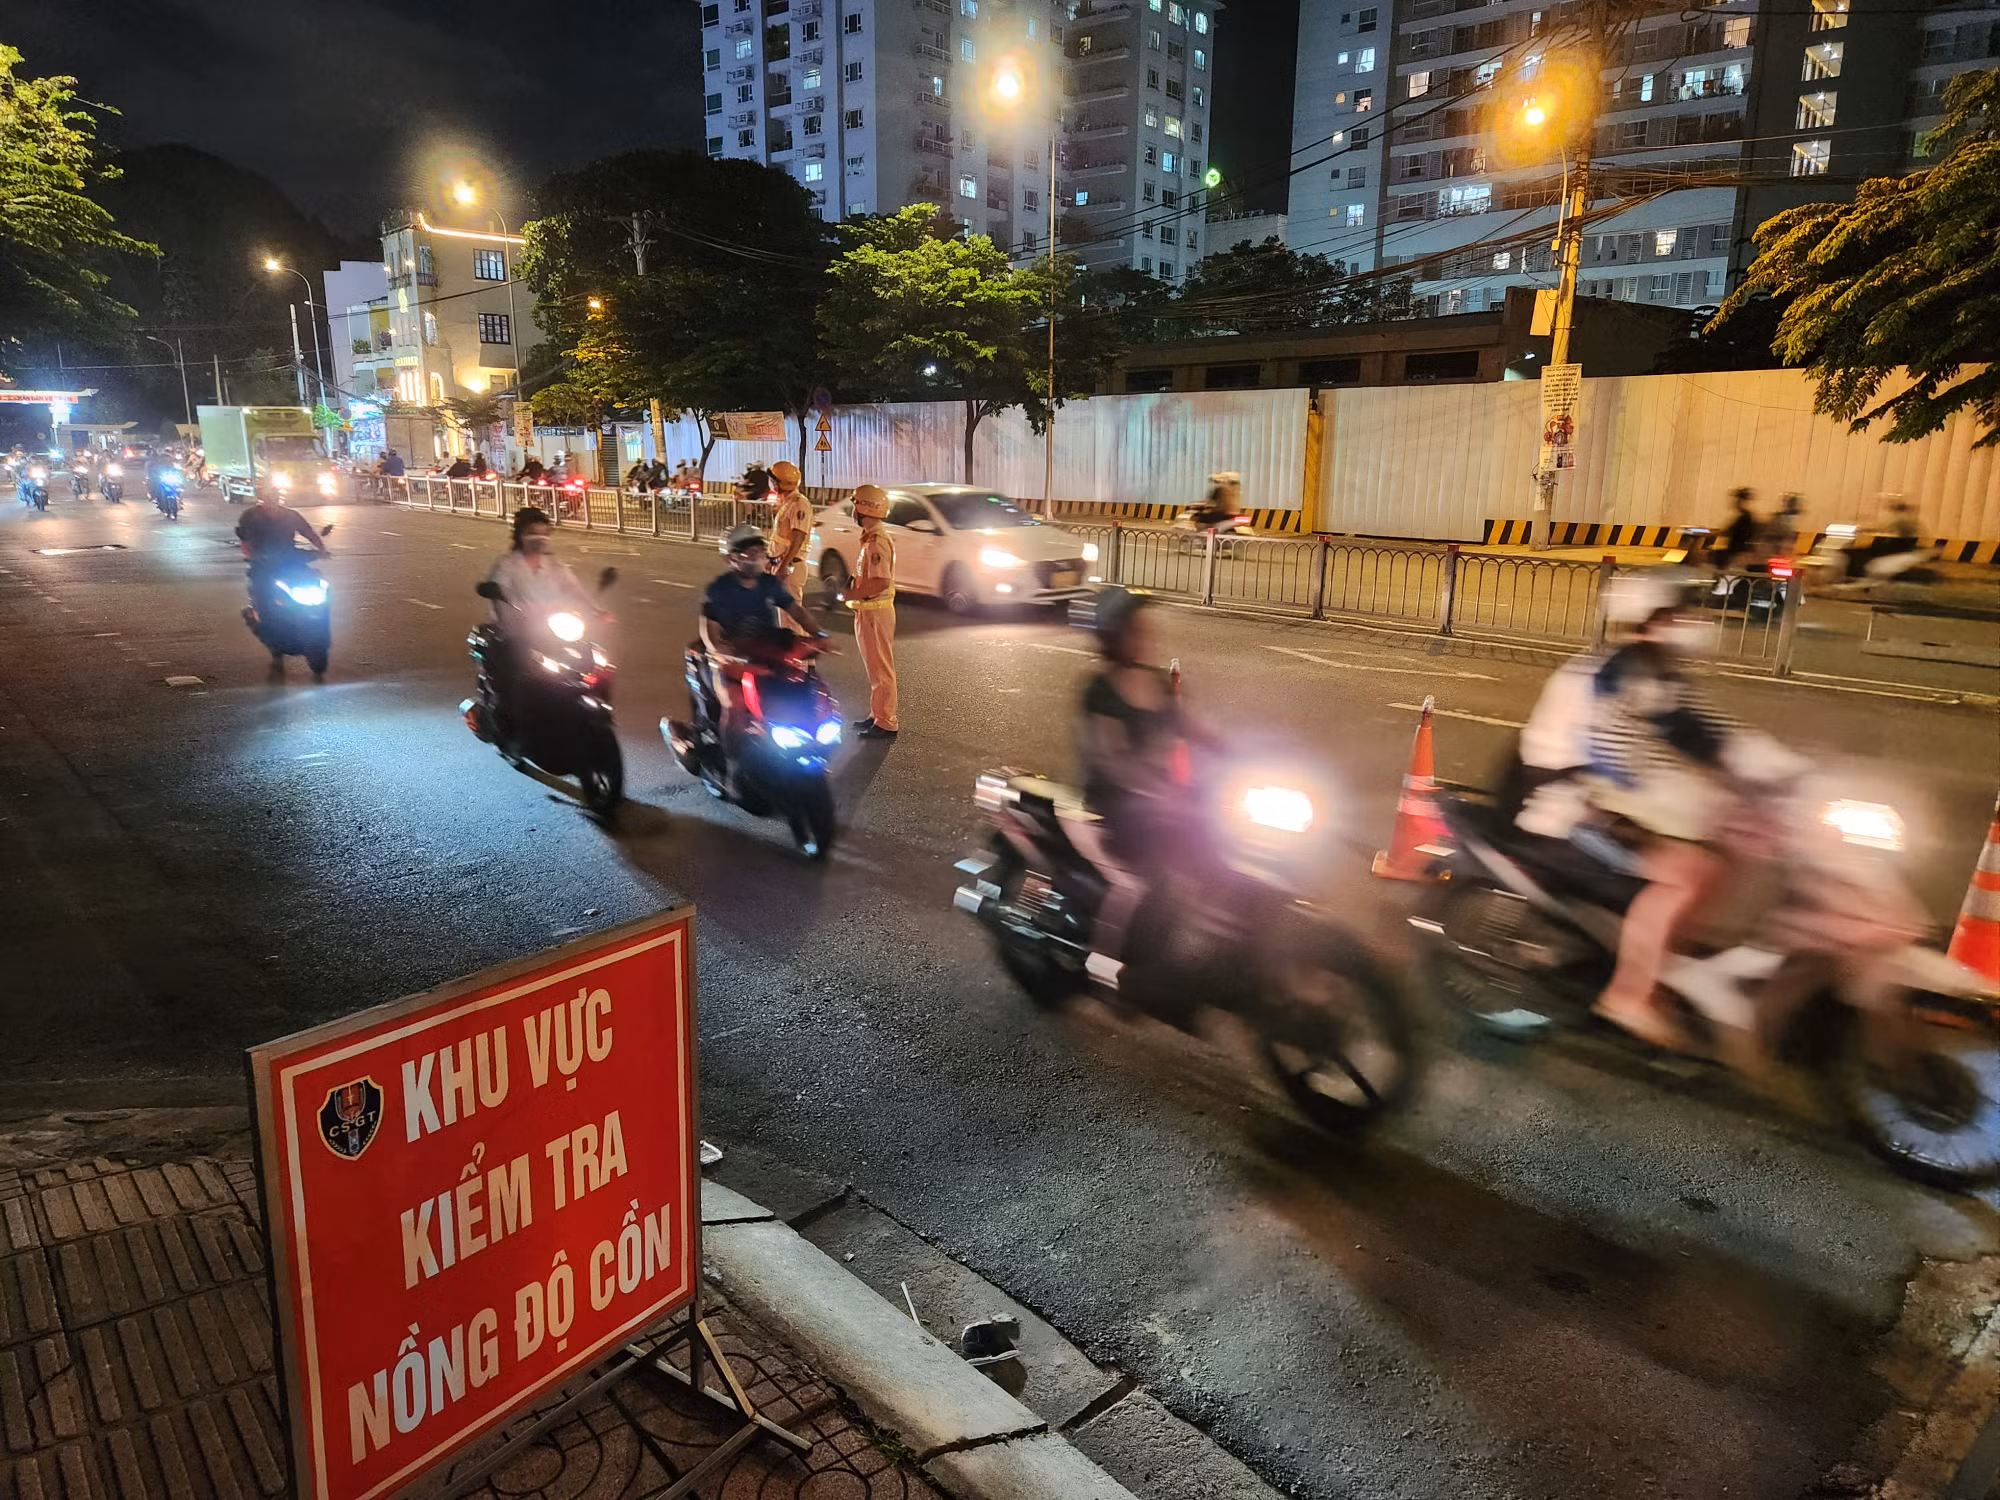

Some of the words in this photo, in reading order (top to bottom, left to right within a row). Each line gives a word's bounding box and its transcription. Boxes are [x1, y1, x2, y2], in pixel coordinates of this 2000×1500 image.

[329, 1110, 377, 1137] CSGT
[402, 1025, 509, 1143] KHU
[522, 986, 613, 1092] VỰC
[399, 1142, 532, 1290] KIỂM
[544, 1109, 629, 1210] TRA
[346, 1306, 500, 1465] NỒNG
[513, 1249, 575, 1362] ĐỘ
[588, 1198, 672, 1313] CỒN
